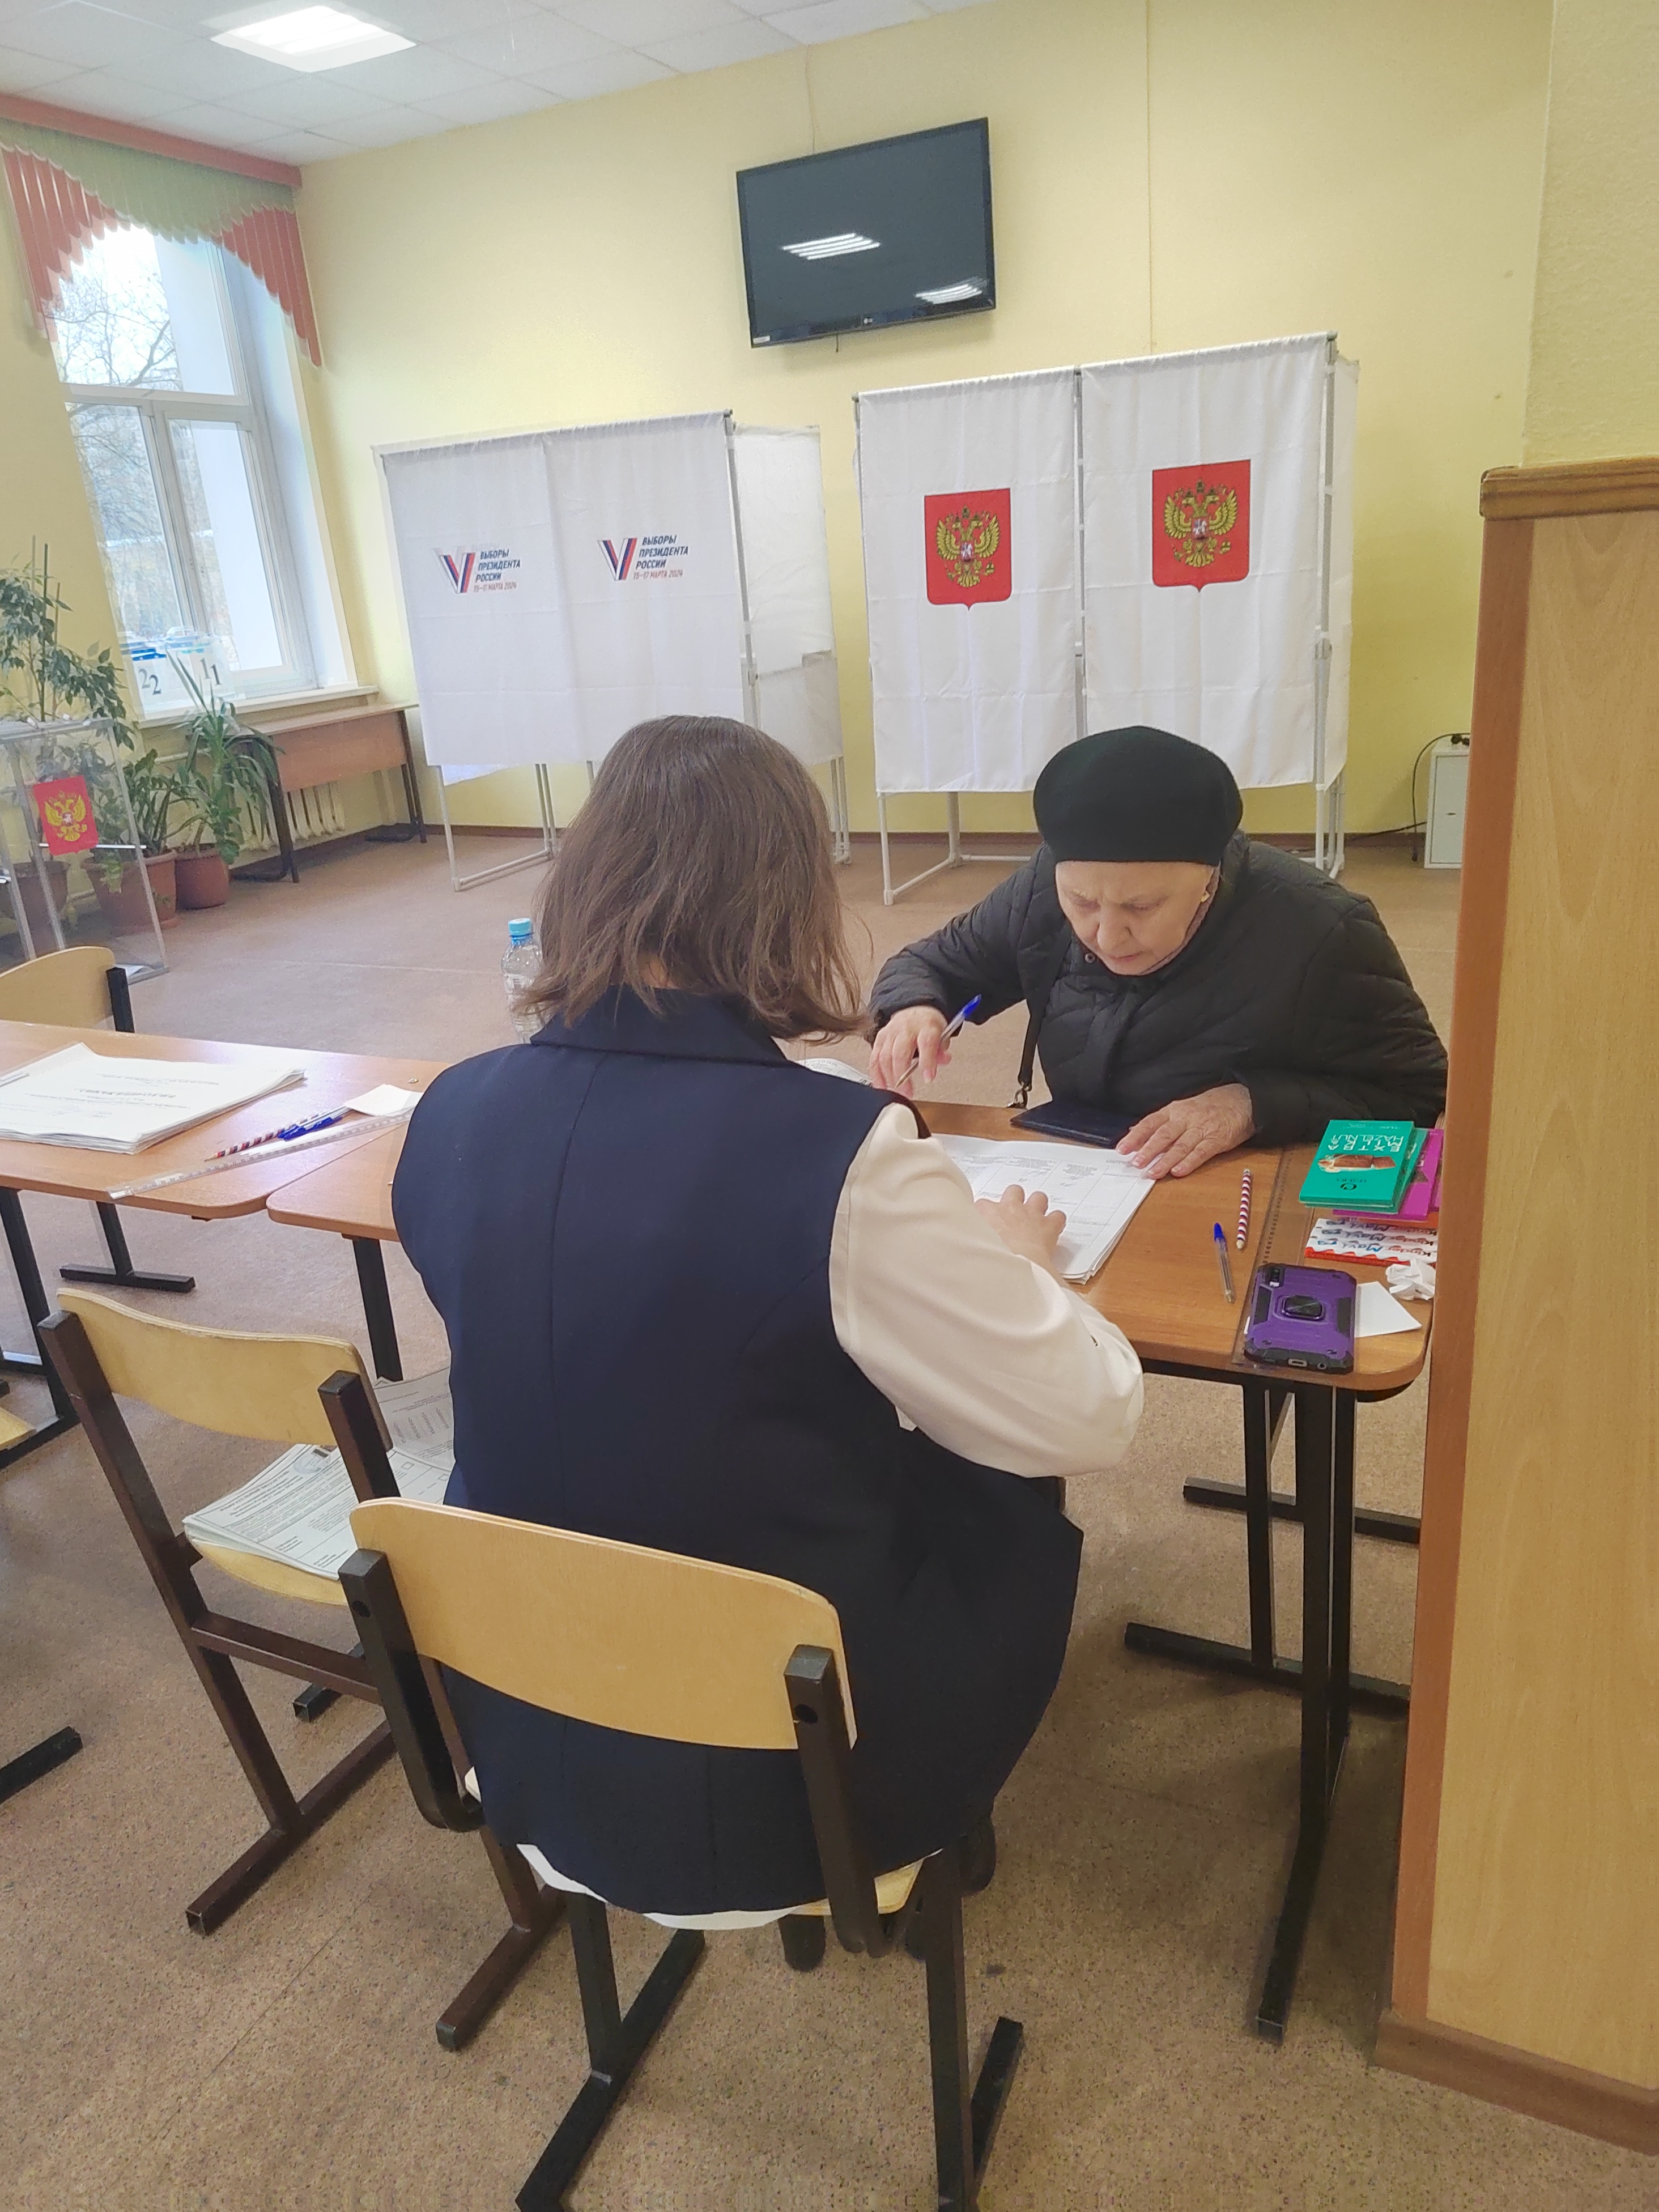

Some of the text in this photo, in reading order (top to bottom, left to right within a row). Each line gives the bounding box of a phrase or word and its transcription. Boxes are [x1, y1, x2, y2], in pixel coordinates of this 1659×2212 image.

[642, 534, 677, 546] ВЫБОРЫ
[480, 548, 509, 560] ВЫБОРЫ
[639, 546, 688, 558] ПРЕЗИДЕНТА
[478, 560, 521, 571] ПРЕЗИДЕНТА
[636, 559, 666, 569] РОССИИ
[476, 572, 501, 582] РОССИИ
[650, 570, 667, 578] МАРТА
